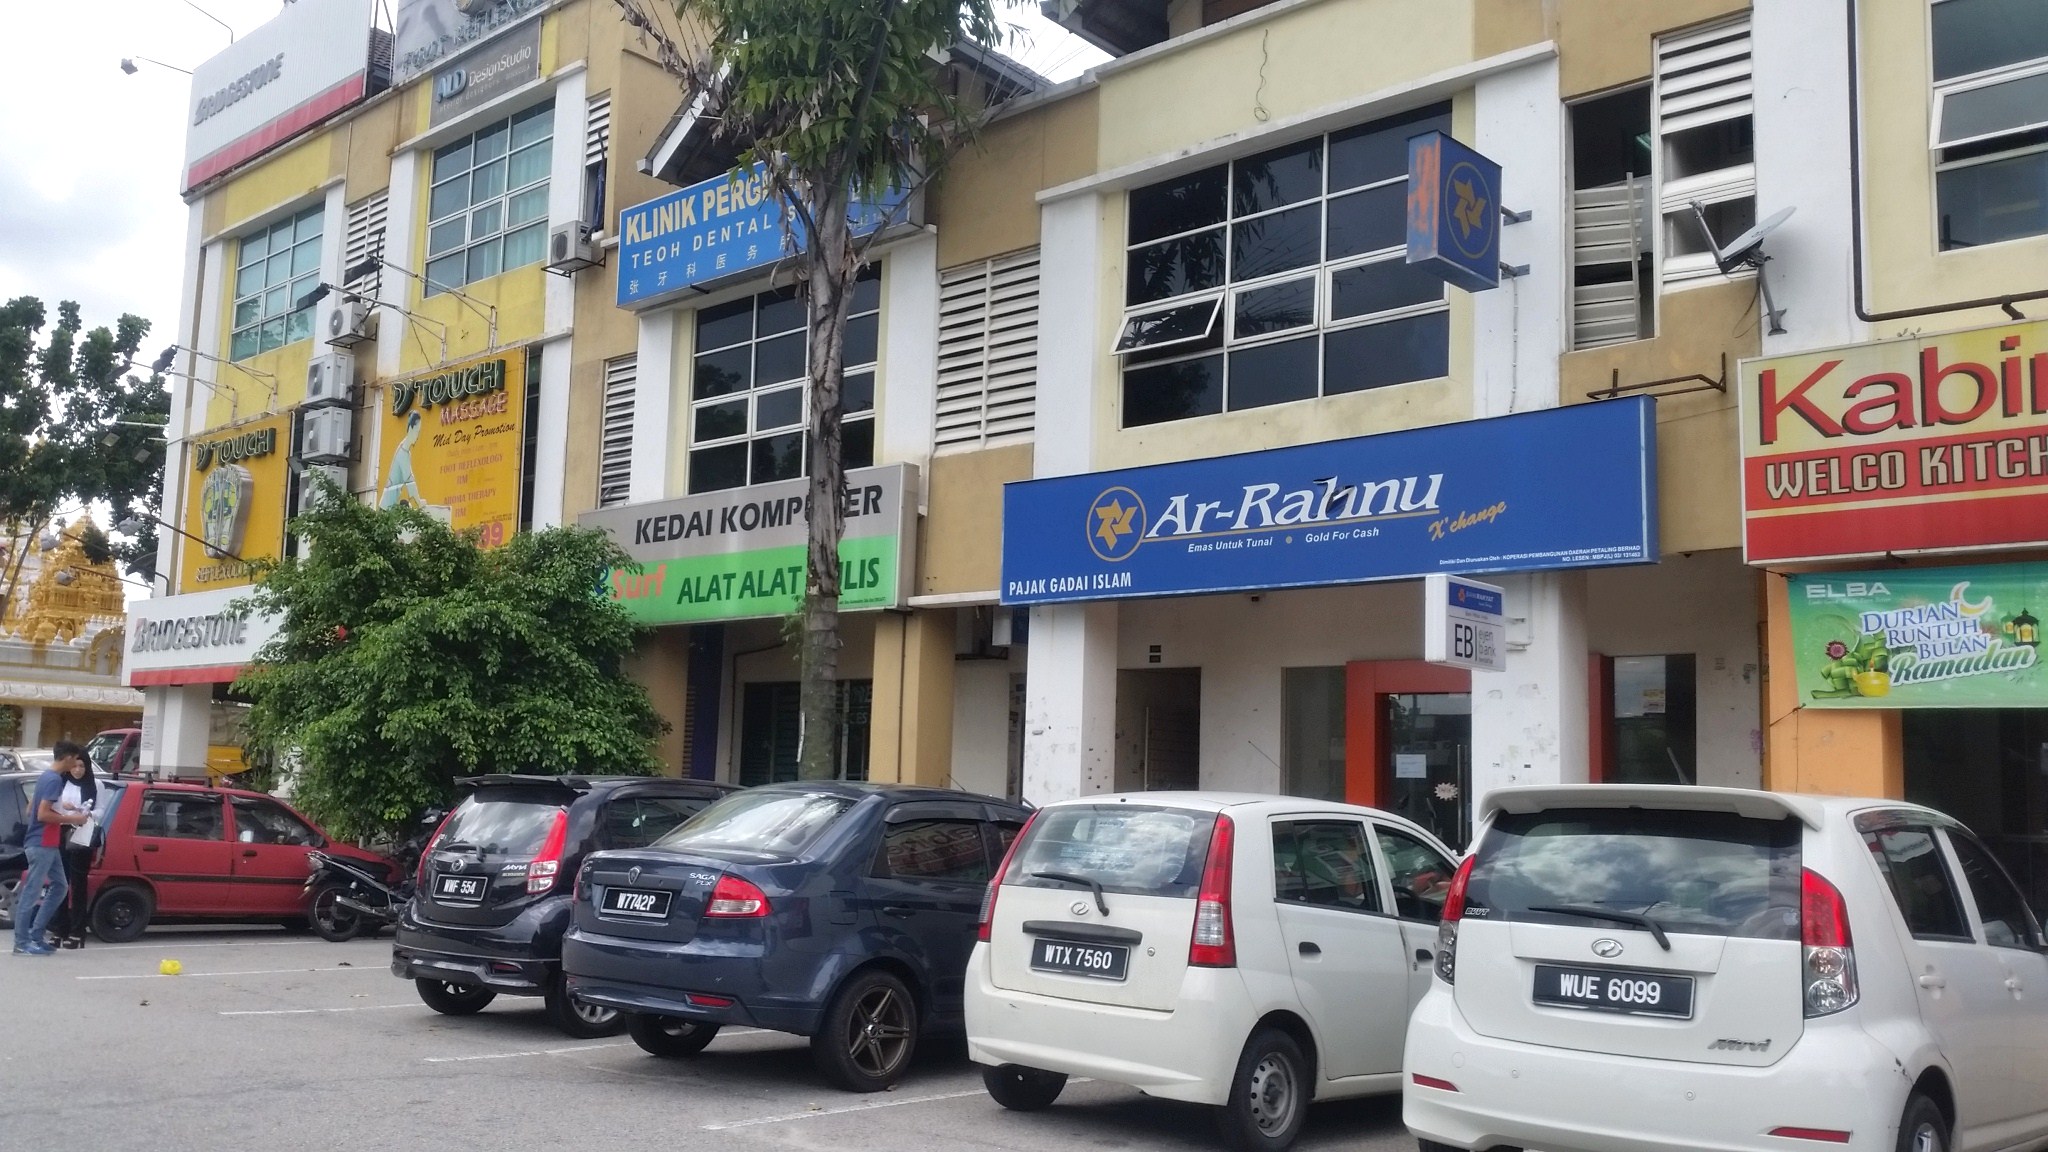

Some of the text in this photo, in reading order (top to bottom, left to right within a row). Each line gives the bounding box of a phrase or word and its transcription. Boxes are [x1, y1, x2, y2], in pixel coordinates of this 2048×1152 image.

[193, 52, 285, 127] BRIDGESTONE
[625, 194, 697, 246] KLINIK
[631, 241, 681, 270] TEOH
[692, 214, 773, 252] DENTAL
[440, 391, 509, 427] MASSAGE
[433, 421, 516, 449] Mid Day Promotion
[1765, 450, 1908, 501] WELCO
[467, 487, 496, 503] THERAPY
[1145, 473, 1444, 539] Ar-Rahnu
[634, 484, 883, 545] KEDAI KOMPER
[1428, 500, 1507, 542] X'change
[1187, 527, 1380, 554] Emas Untuk Tunai Gold For Cash
[1528, 550, 1568, 558] PEMBANGUNAN
[1568, 548, 1591, 556] DAERAH
[676, 571, 737, 606] ALAT
[738, 565, 803, 600] ALAT
[1008, 571, 1132, 597] PAJAK GADAI ISLAM
[1805, 581, 1892, 599] ELBA
[131, 612, 249, 654] BRIDGESTONE
[1863, 602, 1959, 633] DURIAN
[1887, 619, 1978, 646] RUNTUH
[1454, 623, 1474, 659] EB
[1479, 644, 1497, 657] bank
[1919, 636, 1990, 660] BULAN
[1892, 640, 2033, 684] Ramadan
[443, 879, 477, 895] WWF 554
[689, 872, 716, 882] SAGA
[1044, 944, 1113, 970] WTX 7560
[1560, 973, 1661, 1005] WUE 6099
